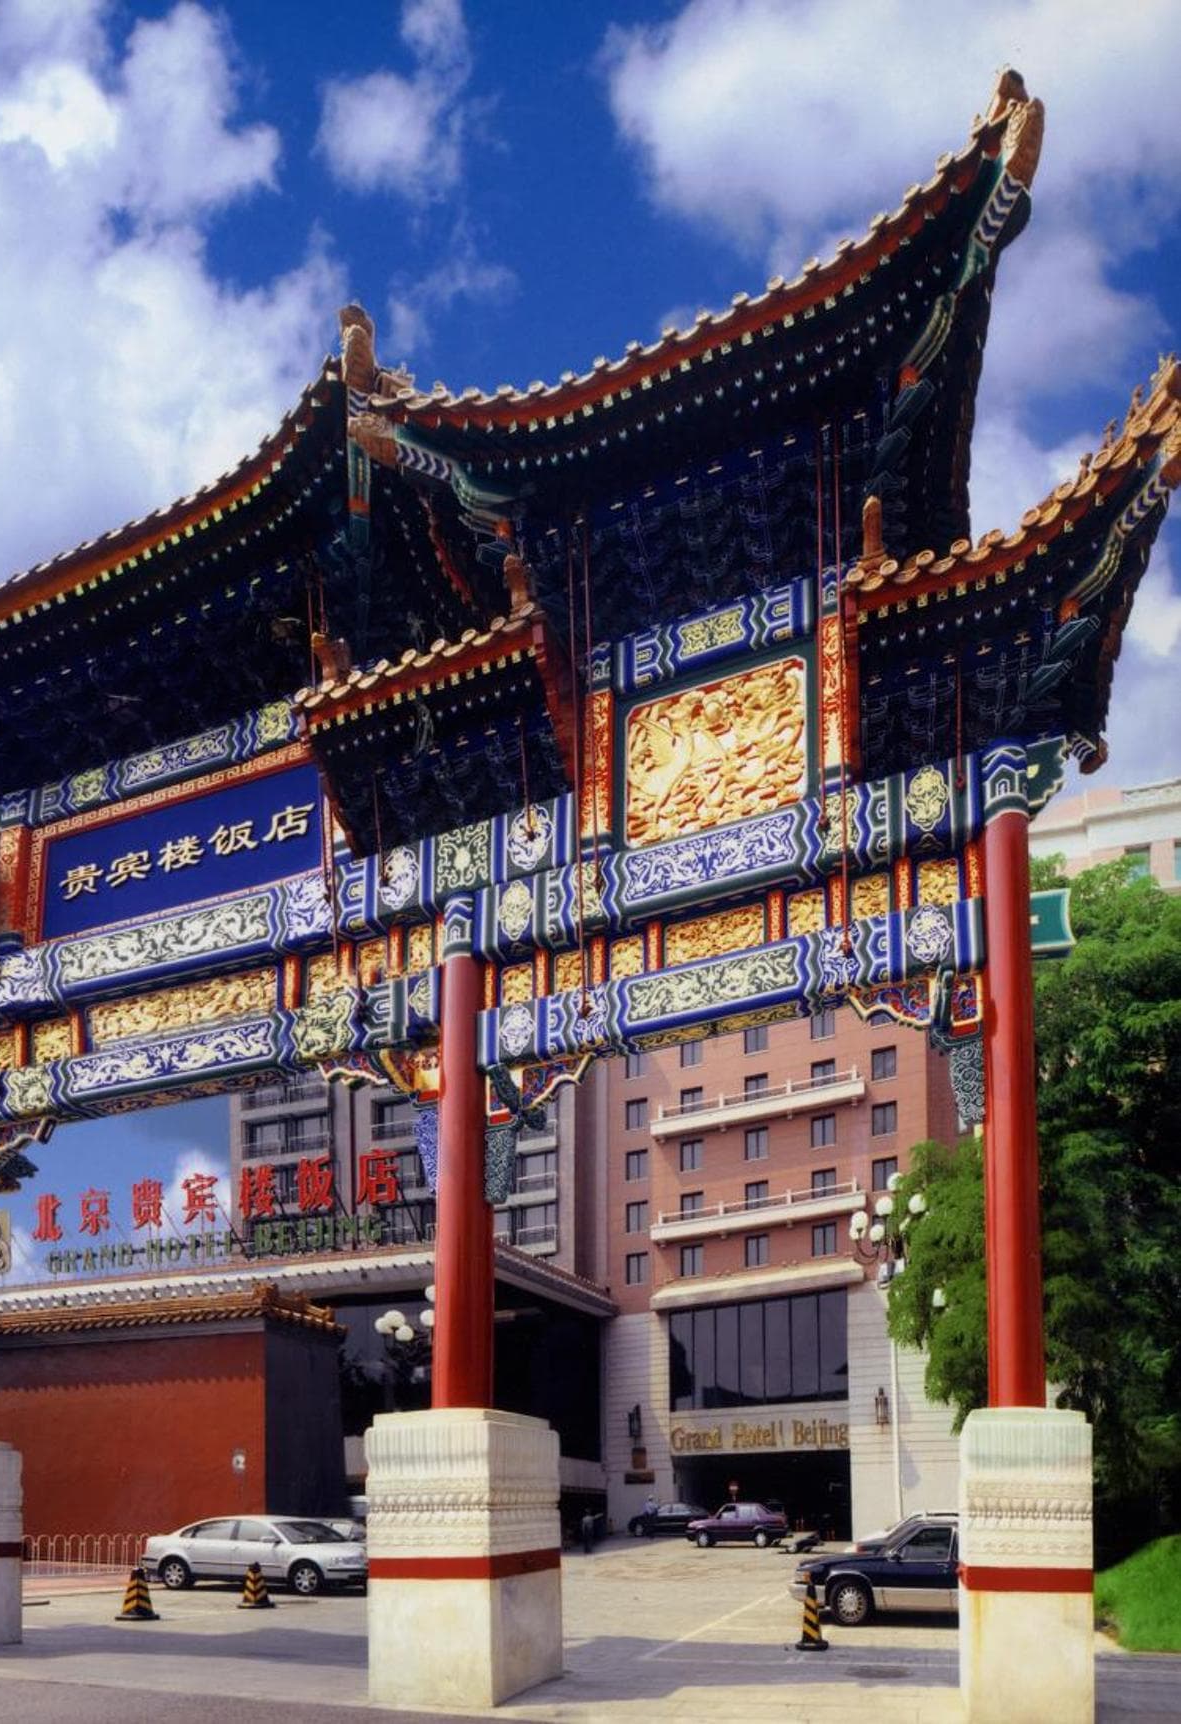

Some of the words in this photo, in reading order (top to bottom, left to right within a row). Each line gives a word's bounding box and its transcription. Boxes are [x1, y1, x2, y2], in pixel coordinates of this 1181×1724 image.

[59, 802, 316, 900] 贵宾楼饭店
[32, 1147, 399, 1243] 北京贵宾楼饭店
[47, 1243, 134, 1274] GRAND
[145, 1231, 233, 1266] HOTEL
[254, 1213, 383, 1255] BEIJING
[671, 1424, 723, 1452] Grand
[731, 1420, 777, 1449] Hotel
[792, 1418, 850, 1449] Beijing
